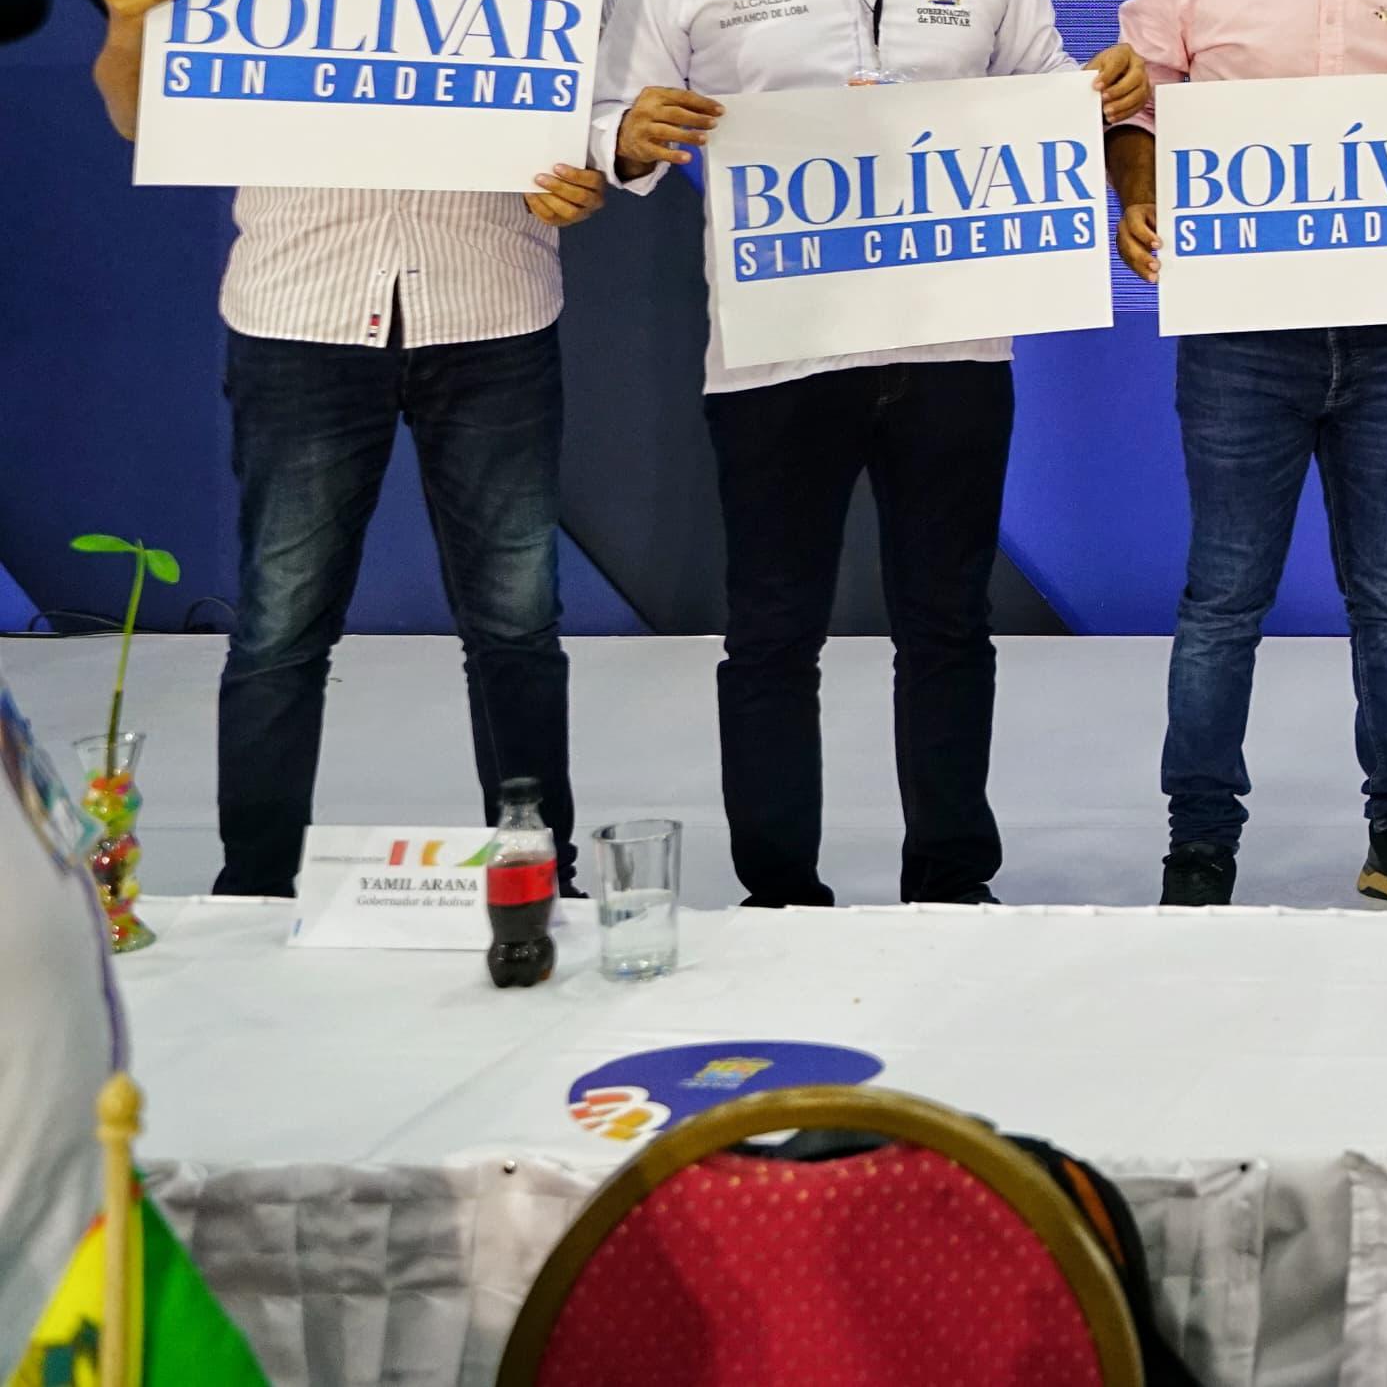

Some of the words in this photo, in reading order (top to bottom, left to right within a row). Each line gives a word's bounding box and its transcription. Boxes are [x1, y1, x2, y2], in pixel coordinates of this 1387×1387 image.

[169, 56, 265, 94] SIN
[314, 63, 573, 107] CADENAS
[726, 131, 1096, 230] BOLÍVAR
[739, 237, 821, 275] SIN
[864, 212, 1091, 264] CADENAS
[1179, 218, 1257, 252] SIN
[360, 877, 417, 891] YAMIL
[419, 877, 479, 891] ARANA
